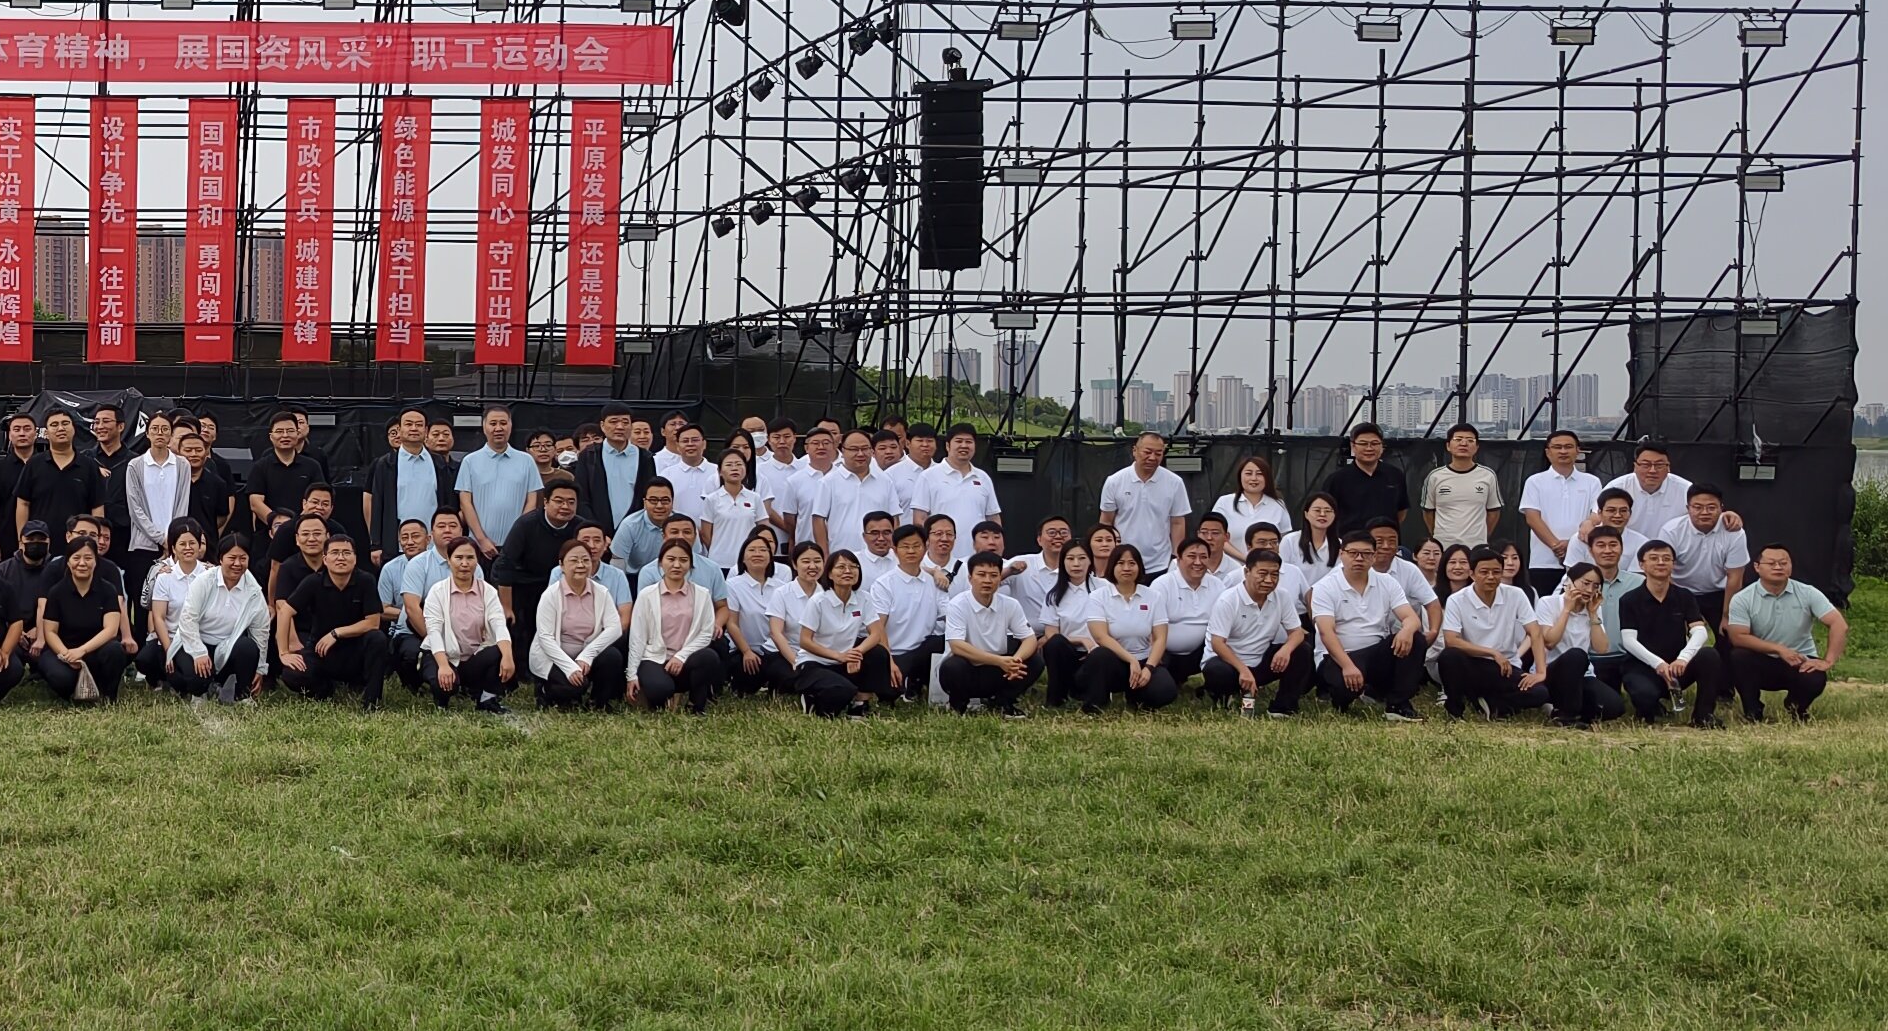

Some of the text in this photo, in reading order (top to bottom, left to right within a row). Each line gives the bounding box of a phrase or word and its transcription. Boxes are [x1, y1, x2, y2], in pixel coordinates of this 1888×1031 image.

[99, 117, 125, 345] 设计争先 一往无前
[196, 122, 223, 339] 国和国和 勇闯第一
[294, 116, 322, 344] 市政尖兵 城建先锋
[389, 116, 418, 344] 绿色能源 实干担当
[487, 118, 516, 346] 城发同心 守正出新
[578, 120, 606, 347] 平原发展 还是发展
